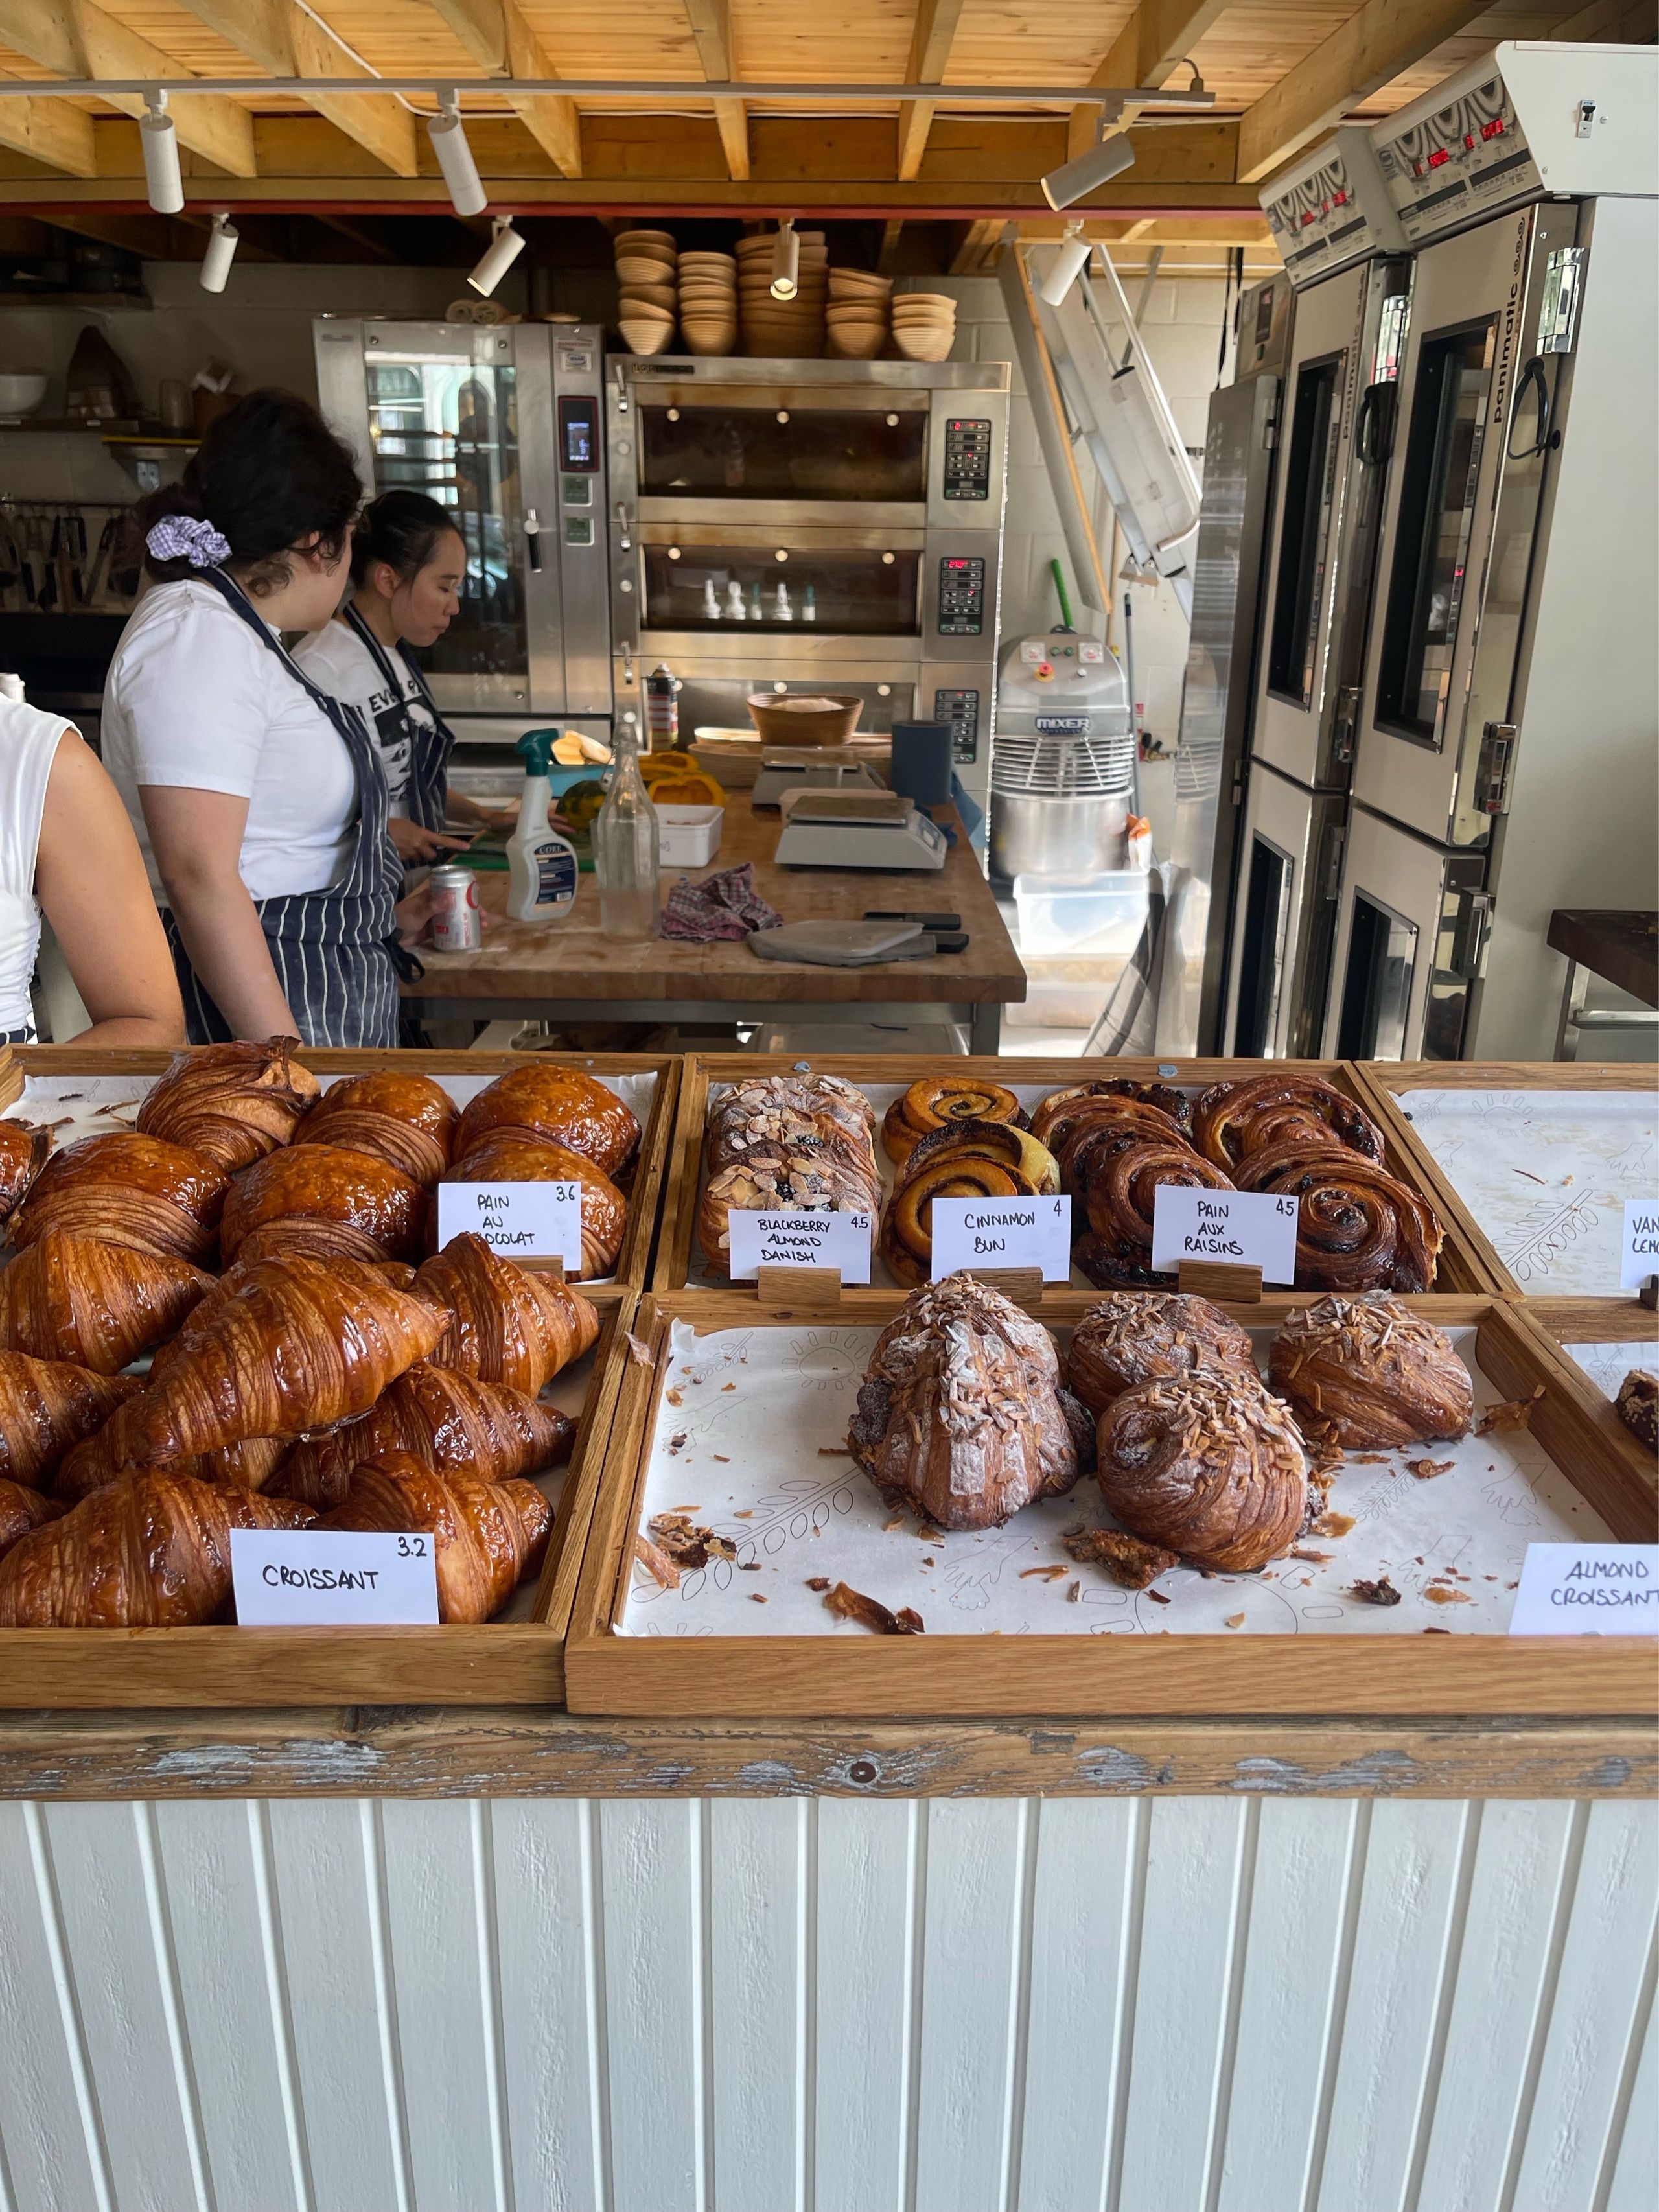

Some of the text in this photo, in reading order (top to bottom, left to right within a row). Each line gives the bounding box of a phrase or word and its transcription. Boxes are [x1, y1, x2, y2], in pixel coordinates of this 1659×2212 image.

[1494, 283, 1518, 423] panimatic
[556, 1185, 575, 1202] 3.6
[477, 1194, 509, 1211] PAIN
[1054, 1199, 1062, 1217] 4
[1197, 1201, 1229, 1218] PAIN
[483, 1216, 503, 1228] AU
[758, 1219, 831, 1233] BLACKBERRY
[851, 1217, 868, 1229] 4.5
[964, 1212, 1035, 1229] CINNAMON
[1198, 1222, 1224, 1235] AUX
[485, 1232, 535, 1246] OCOLAT
[767, 1233, 822, 1247] ALMOND
[973, 1236, 1005, 1253] BUN
[1185, 1236, 1244, 1255] RAISINS
[761, 1249, 816, 1263] DANISH
[397, 1536, 427, 1557] 3.2
[262, 1565, 379, 1589] CROISSANT
[1564, 1560, 1649, 1581] ALMOND
